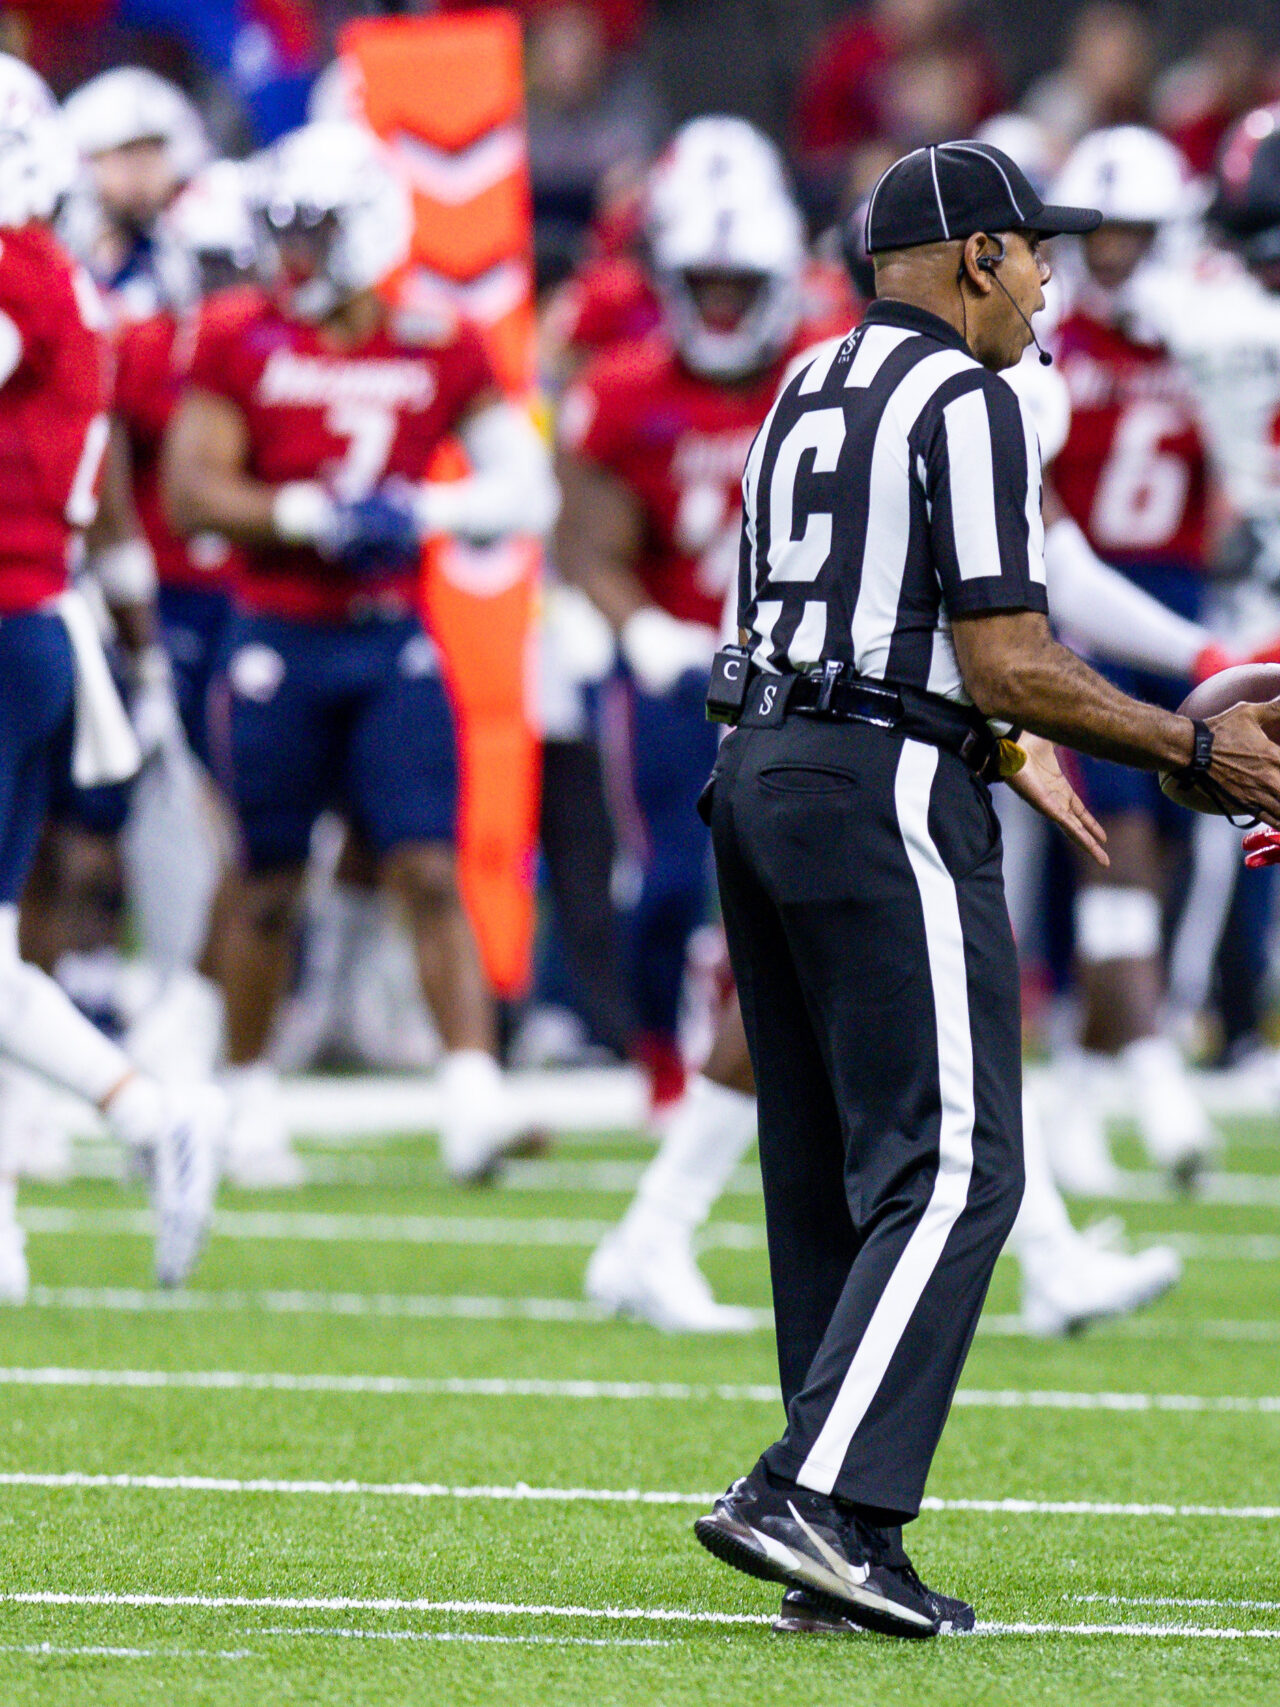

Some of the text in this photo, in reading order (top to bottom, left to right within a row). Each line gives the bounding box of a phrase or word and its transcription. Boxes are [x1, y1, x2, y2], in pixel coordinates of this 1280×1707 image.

[767, 406, 847, 583] C
[1092, 402, 1193, 548] 6
[722, 660, 741, 681] C
